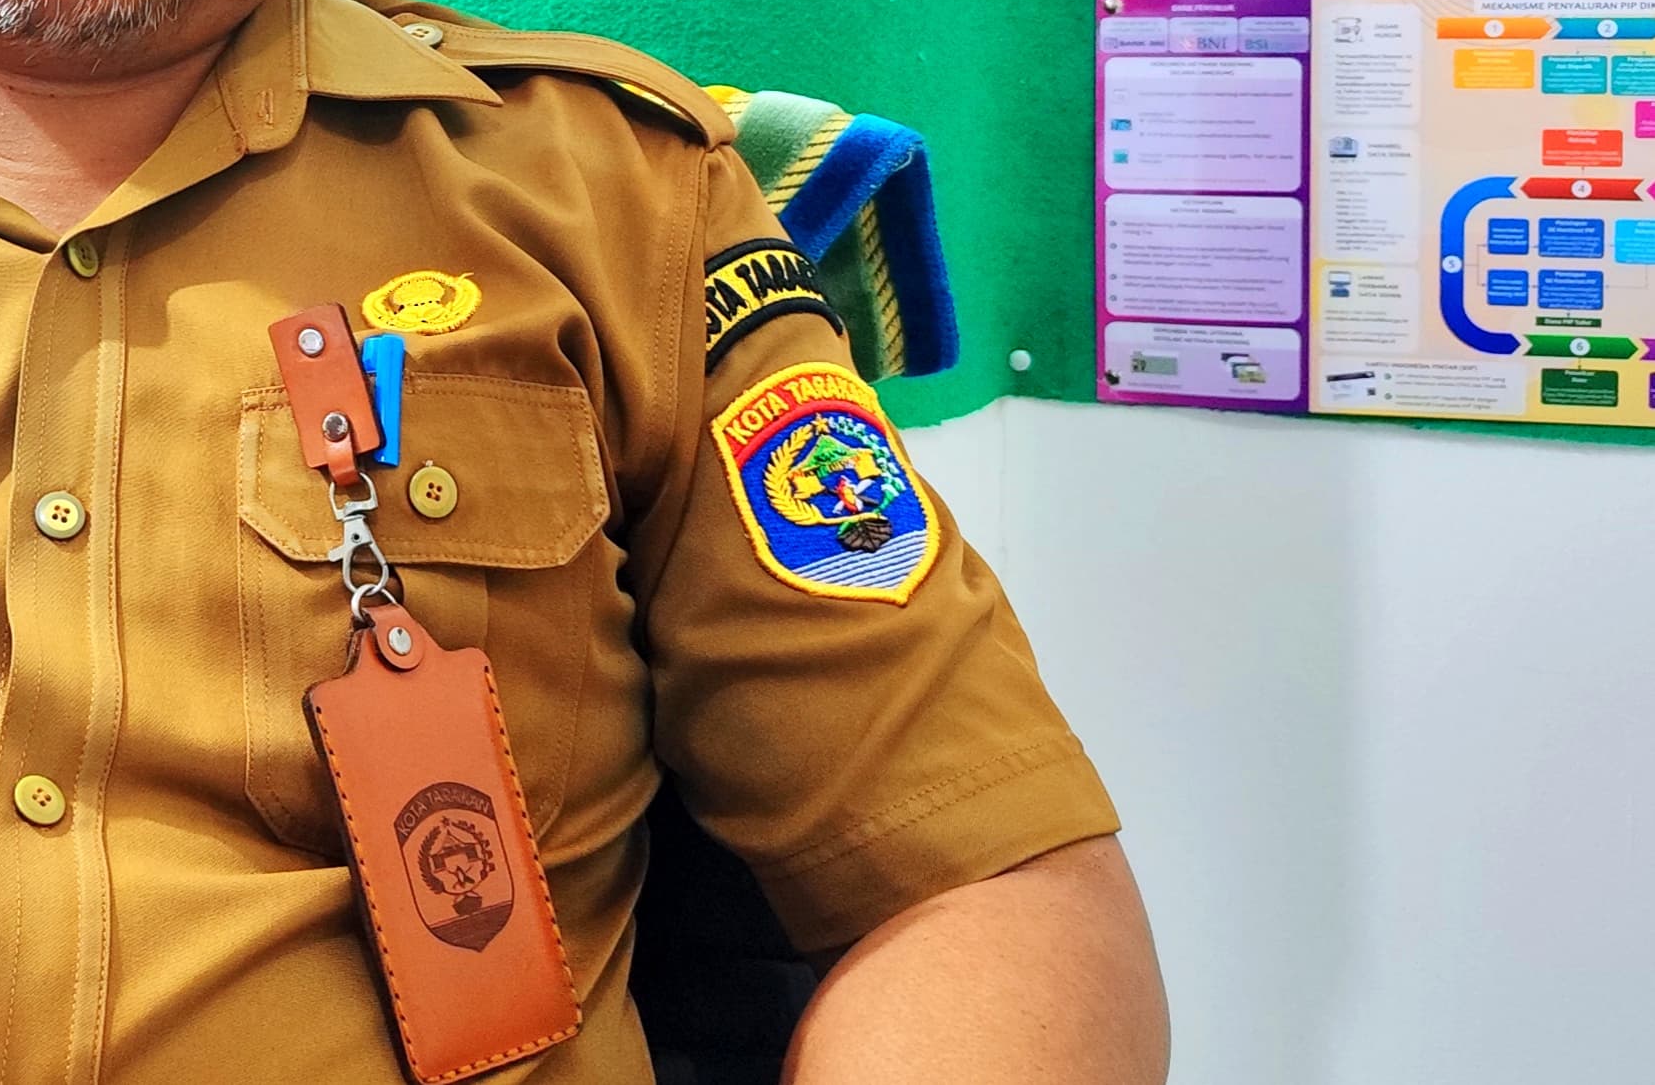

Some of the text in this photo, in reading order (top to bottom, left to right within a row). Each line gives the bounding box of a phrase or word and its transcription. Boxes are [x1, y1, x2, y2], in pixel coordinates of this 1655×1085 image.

[1481, 2, 1545, 11] MEKANISME
[1547, 2, 1618, 10] PENYALURAN
[1605, 24, 1611, 33] 2
[1197, 37, 1227, 50] BNI
[1576, 342, 1583, 351] 6
[726, 392, 789, 445] KOTA
[397, 788, 490, 836] KOTA TARAKAN
